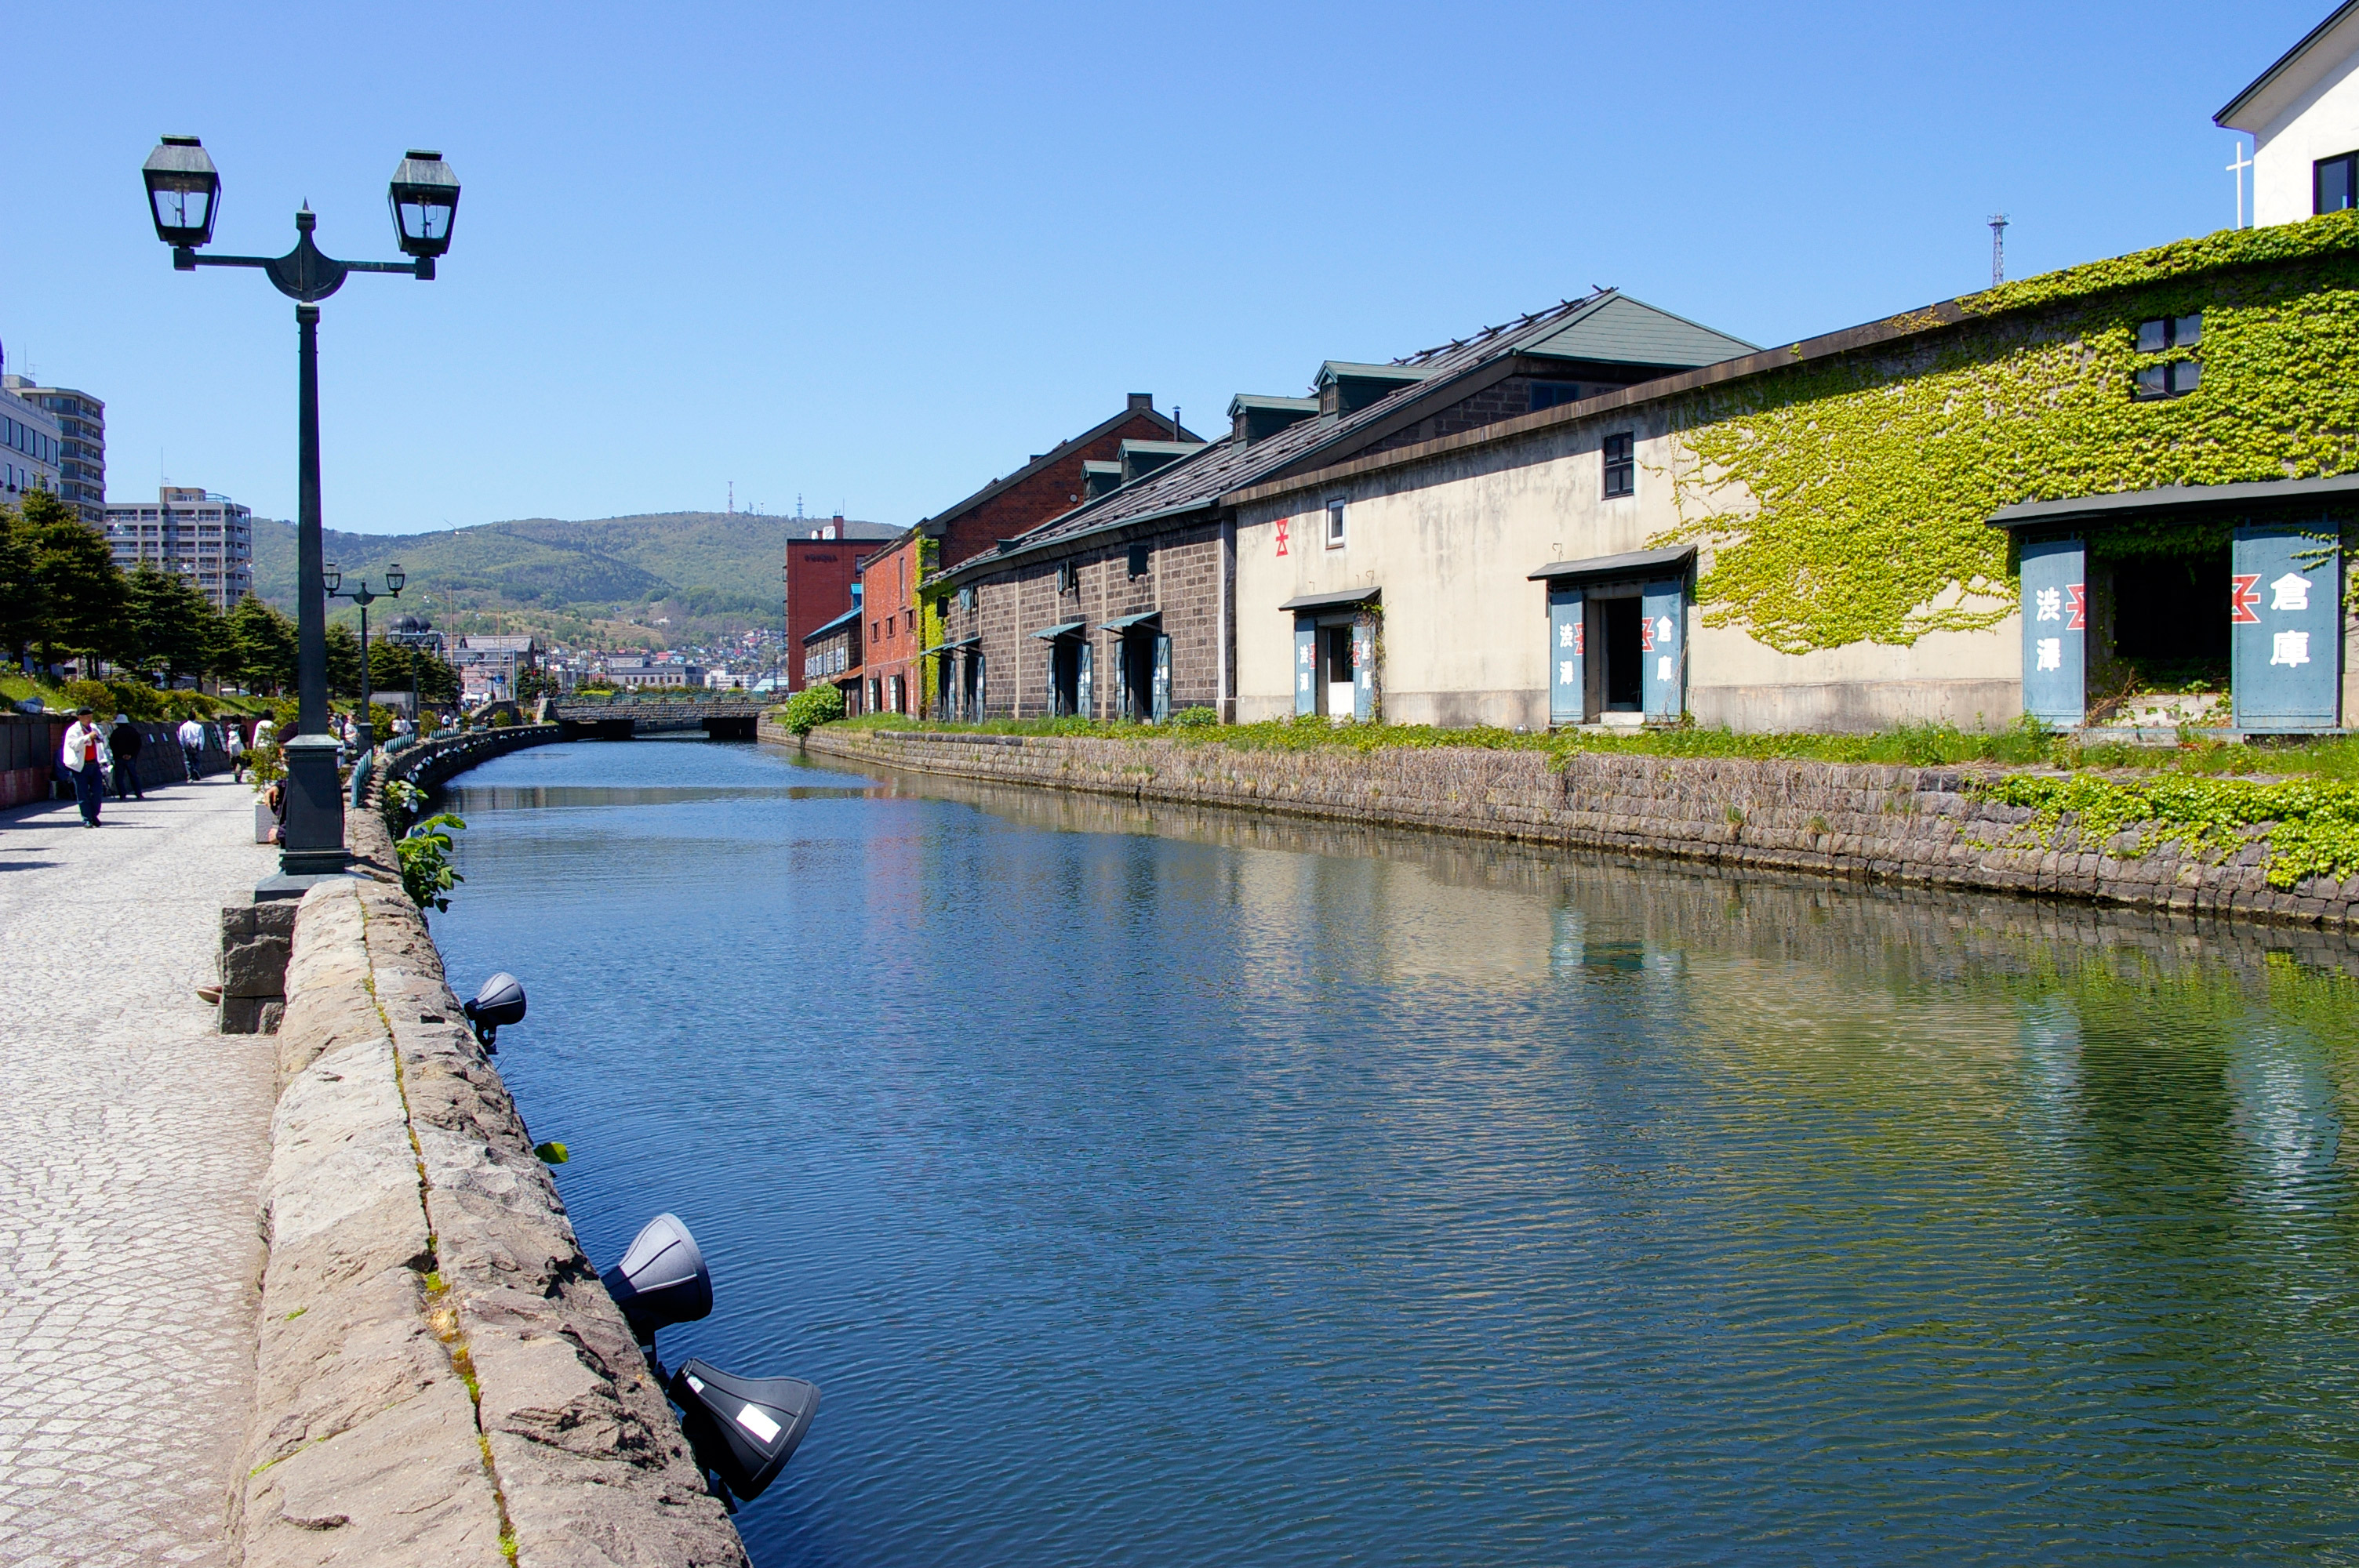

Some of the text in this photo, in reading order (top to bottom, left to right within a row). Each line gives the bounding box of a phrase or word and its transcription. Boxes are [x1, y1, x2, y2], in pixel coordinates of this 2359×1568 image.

[1656, 615, 1674, 683] 倉庫
[2036, 586, 2062, 672] 渋澤
[2269, 572, 2313, 668] 倉庫
